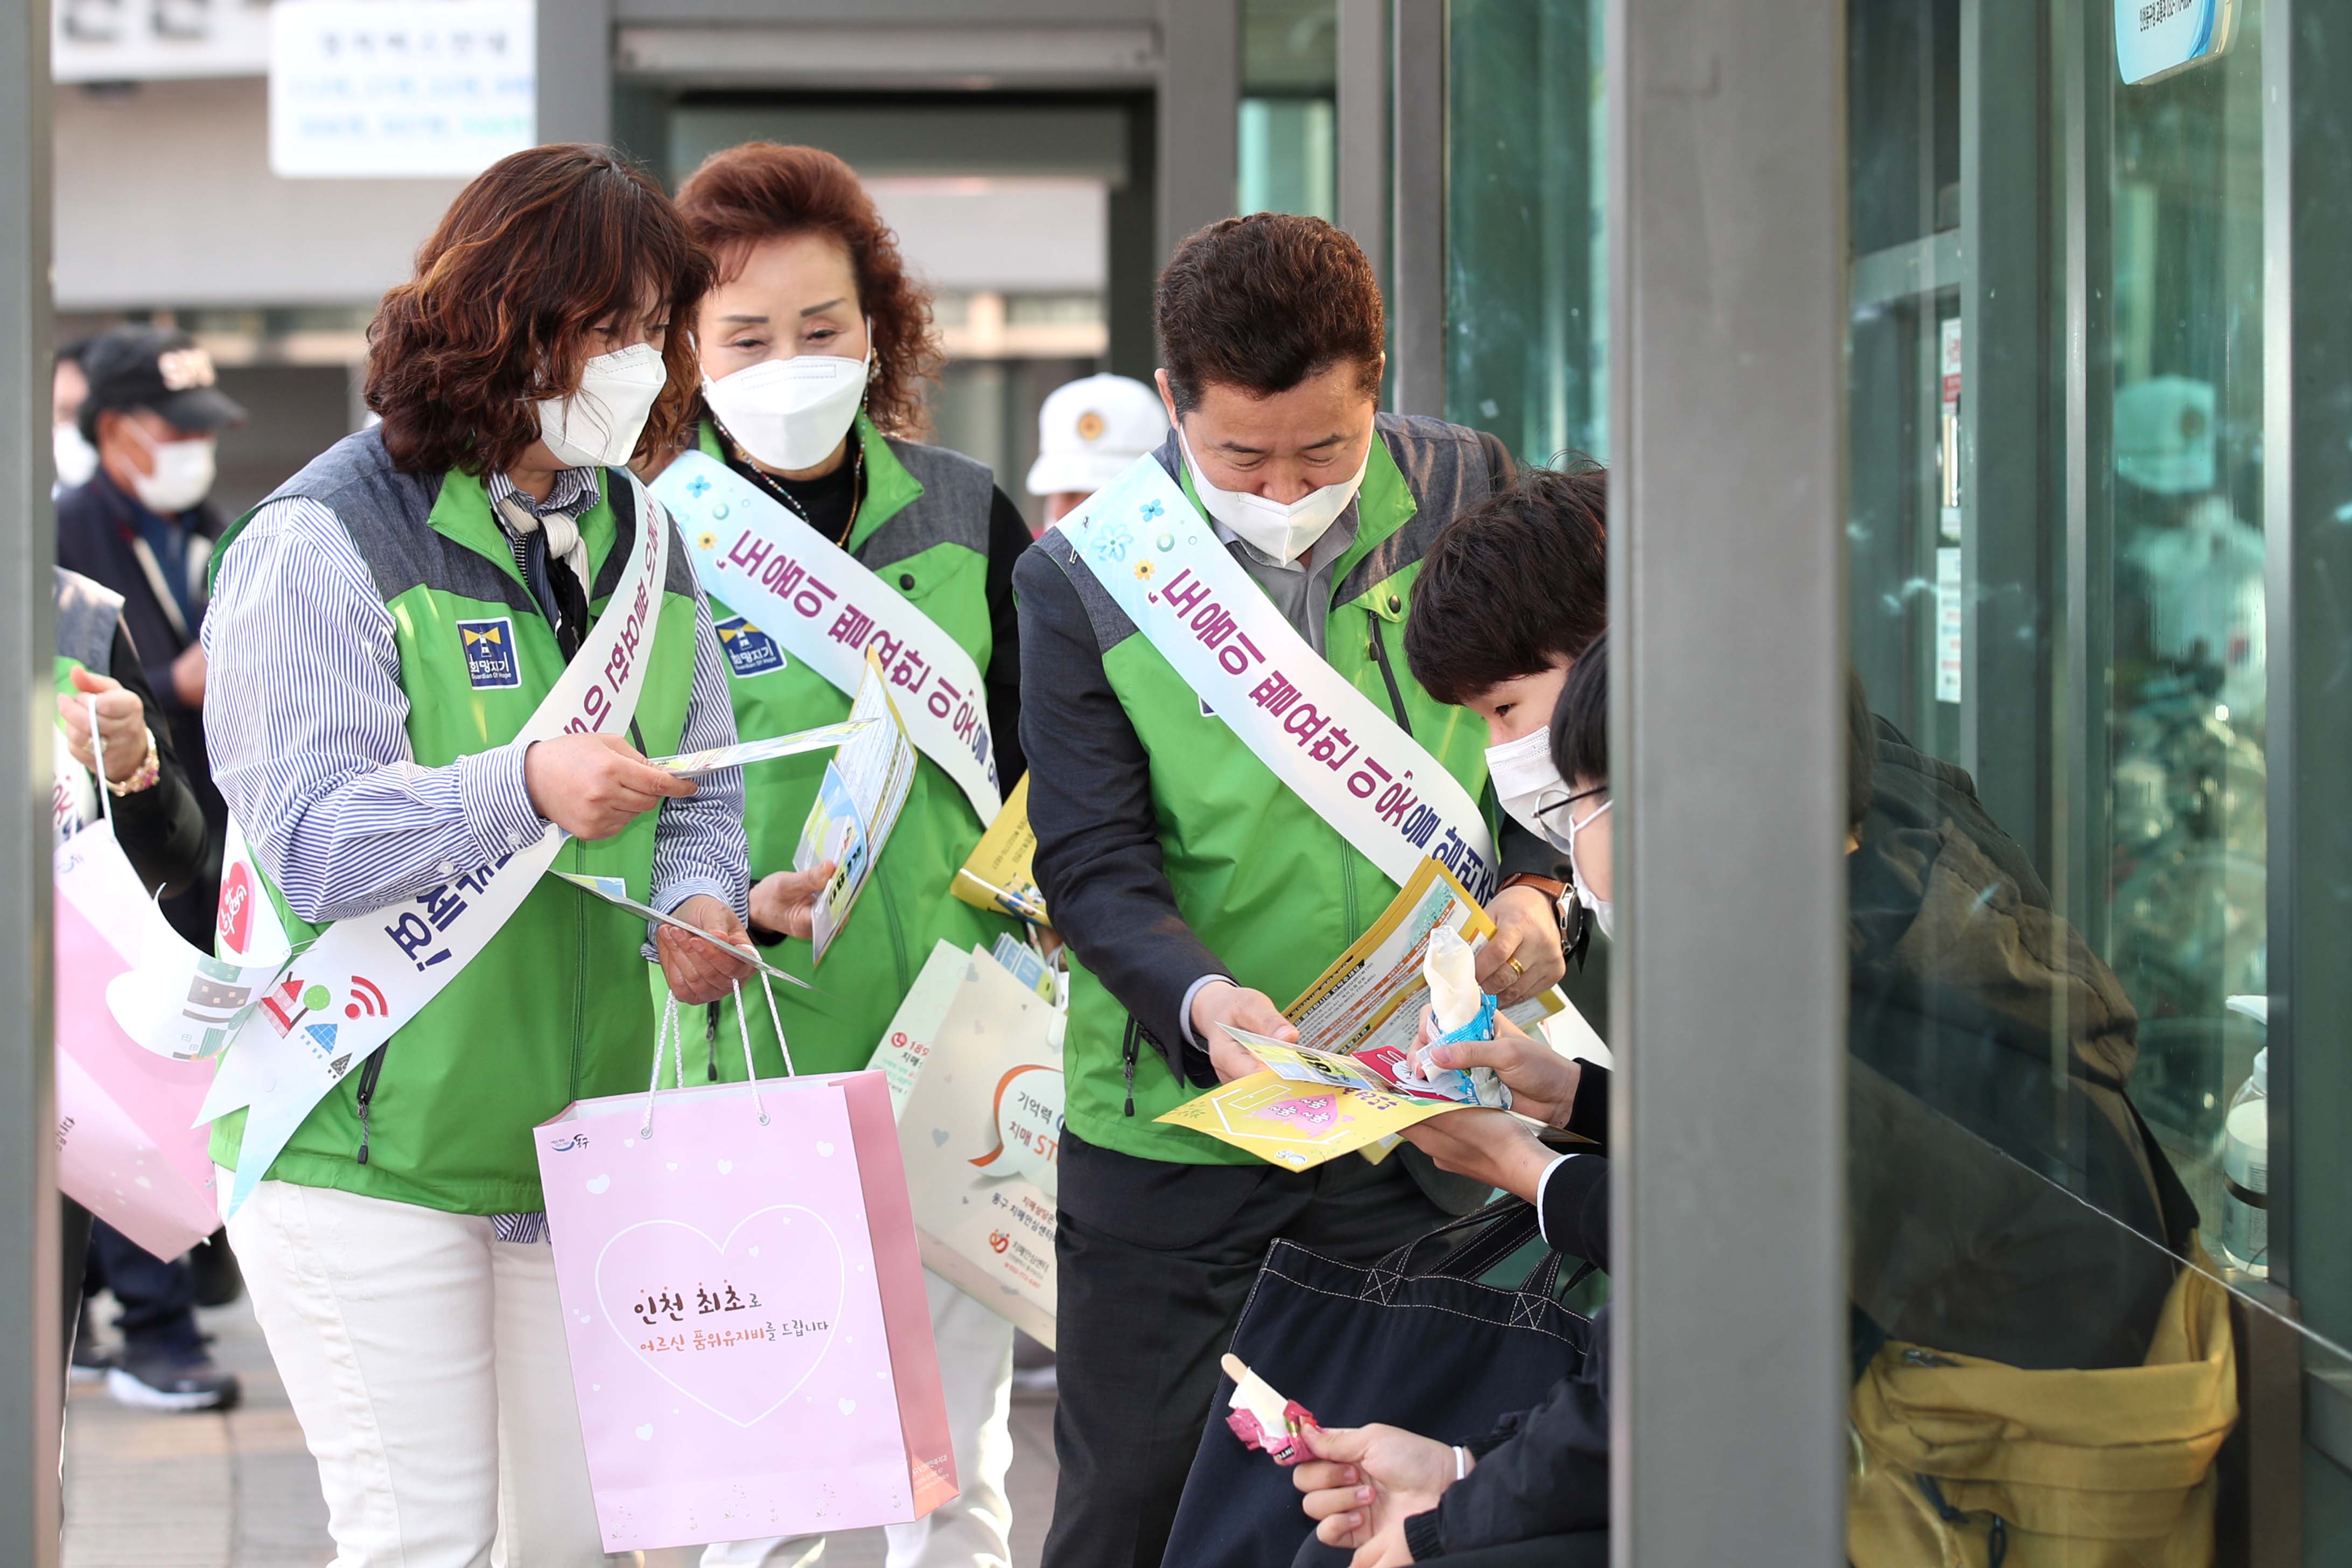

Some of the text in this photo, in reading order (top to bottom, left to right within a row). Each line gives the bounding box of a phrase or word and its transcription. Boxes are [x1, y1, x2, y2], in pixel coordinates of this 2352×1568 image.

[469, 651, 509, 673] 희망지기
[729, 638, 774, 665] 희망지기
[828, 604, 933, 695] 필요한
[1248, 670, 1360, 772] 필요한
[909, 1041, 930, 1056] 189
[1017, 1091, 1053, 1125] 기억력
[573, 1133, 591, 1150] 동구
[1009, 1120, 1033, 1147] 치매
[1033, 1133, 1058, 1164] ST
[633, 1282, 762, 1325] 인천 최초로
[640, 1319, 829, 1352] 어르신 품위유지비를 드립니다
